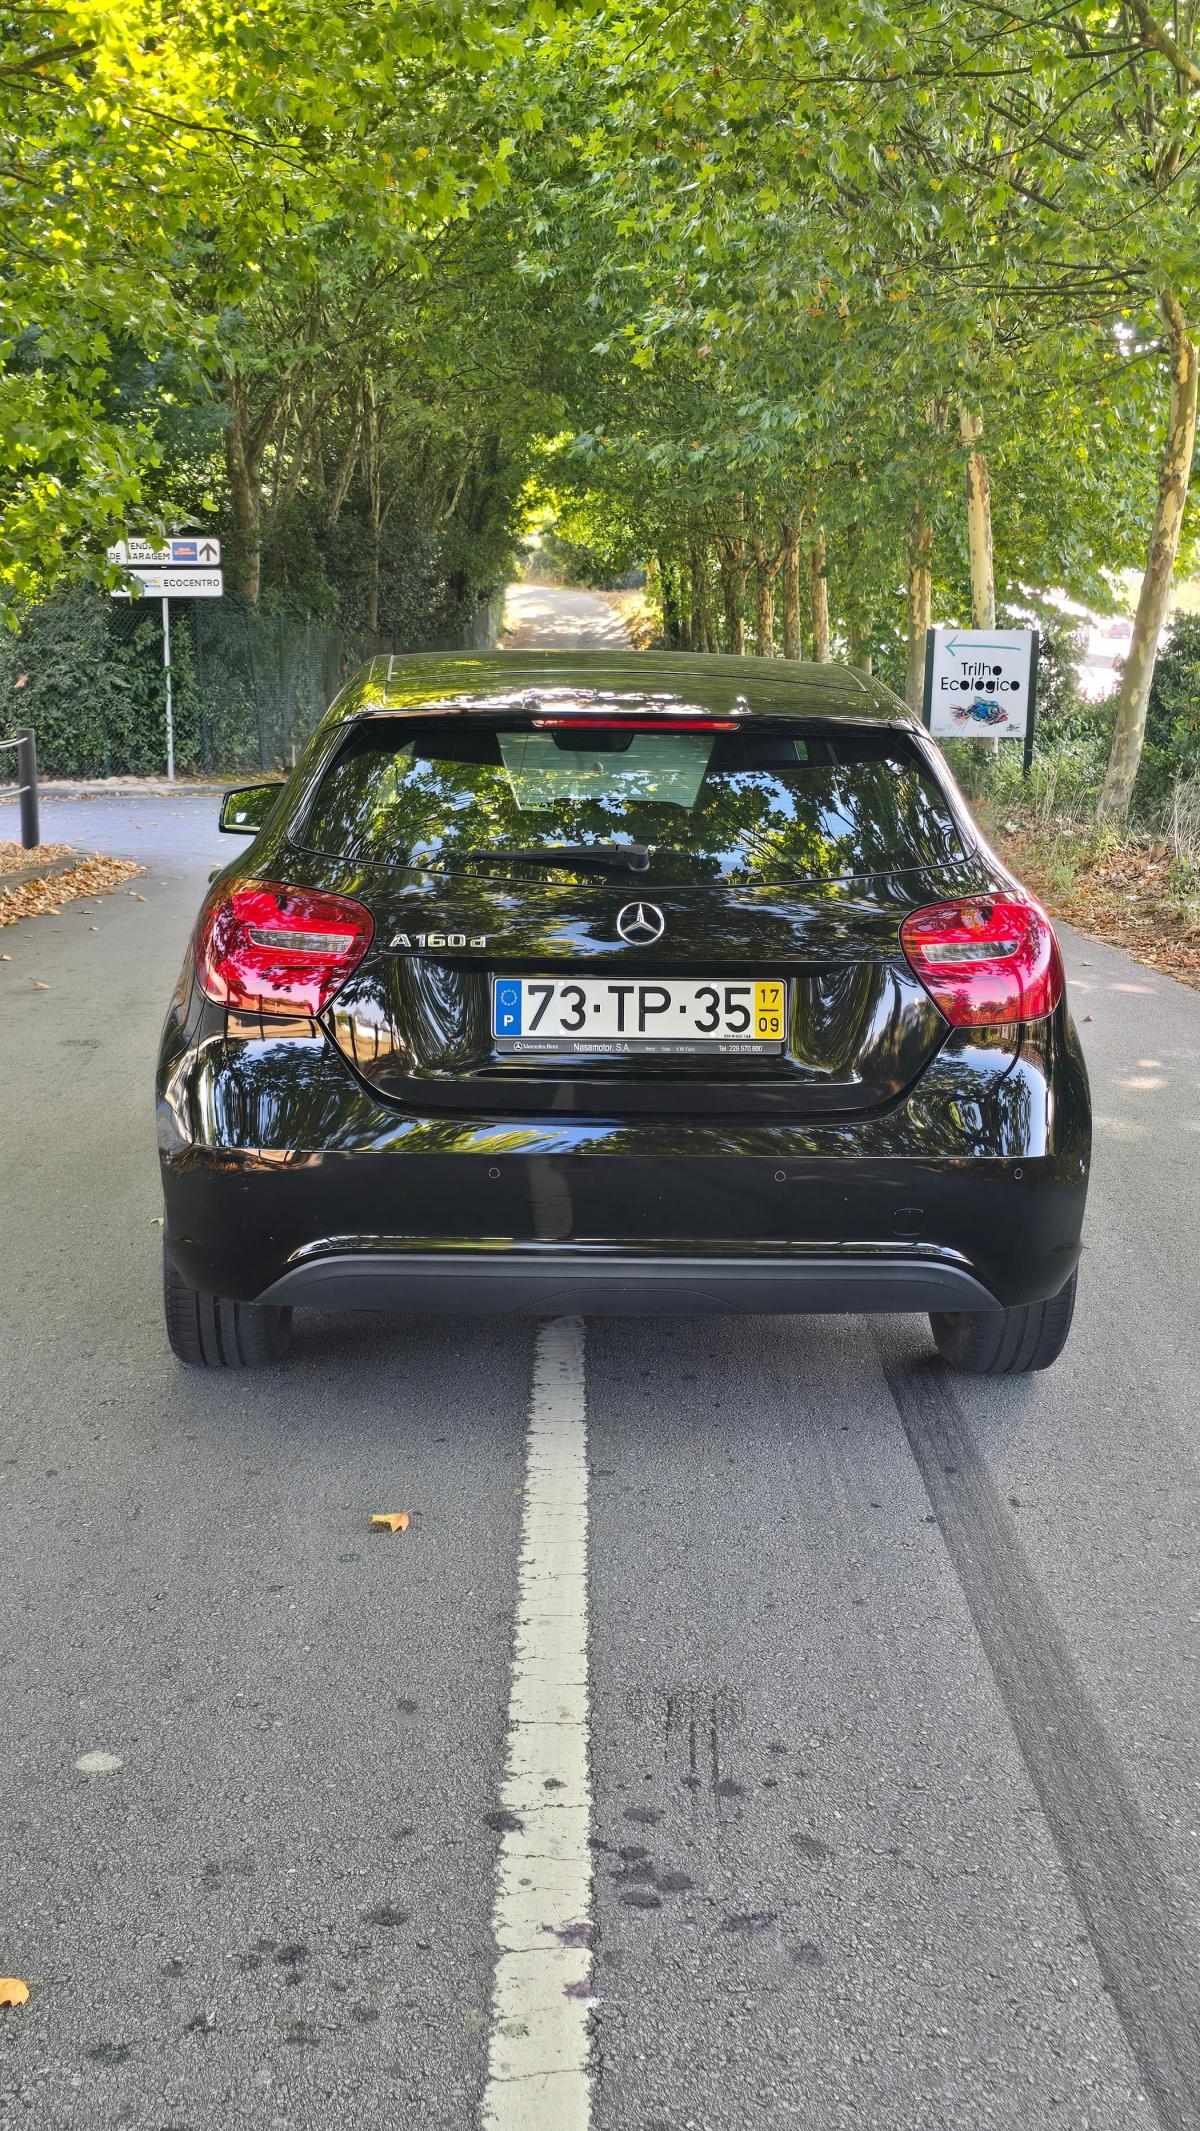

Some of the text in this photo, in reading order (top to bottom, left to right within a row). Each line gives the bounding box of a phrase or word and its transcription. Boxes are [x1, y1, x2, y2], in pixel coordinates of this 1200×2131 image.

[128, 542, 152, 550] END
[109, 552, 121, 560] DE
[163, 579, 220, 587] ECOCENTRO
[961, 662, 1003, 676] Trilho
[940, 676, 1020, 694] Ecológico
[760, 988, 780, 1004] 17
[503, 1014, 514, 1027] P
[758, 1017, 780, 1033] 09
